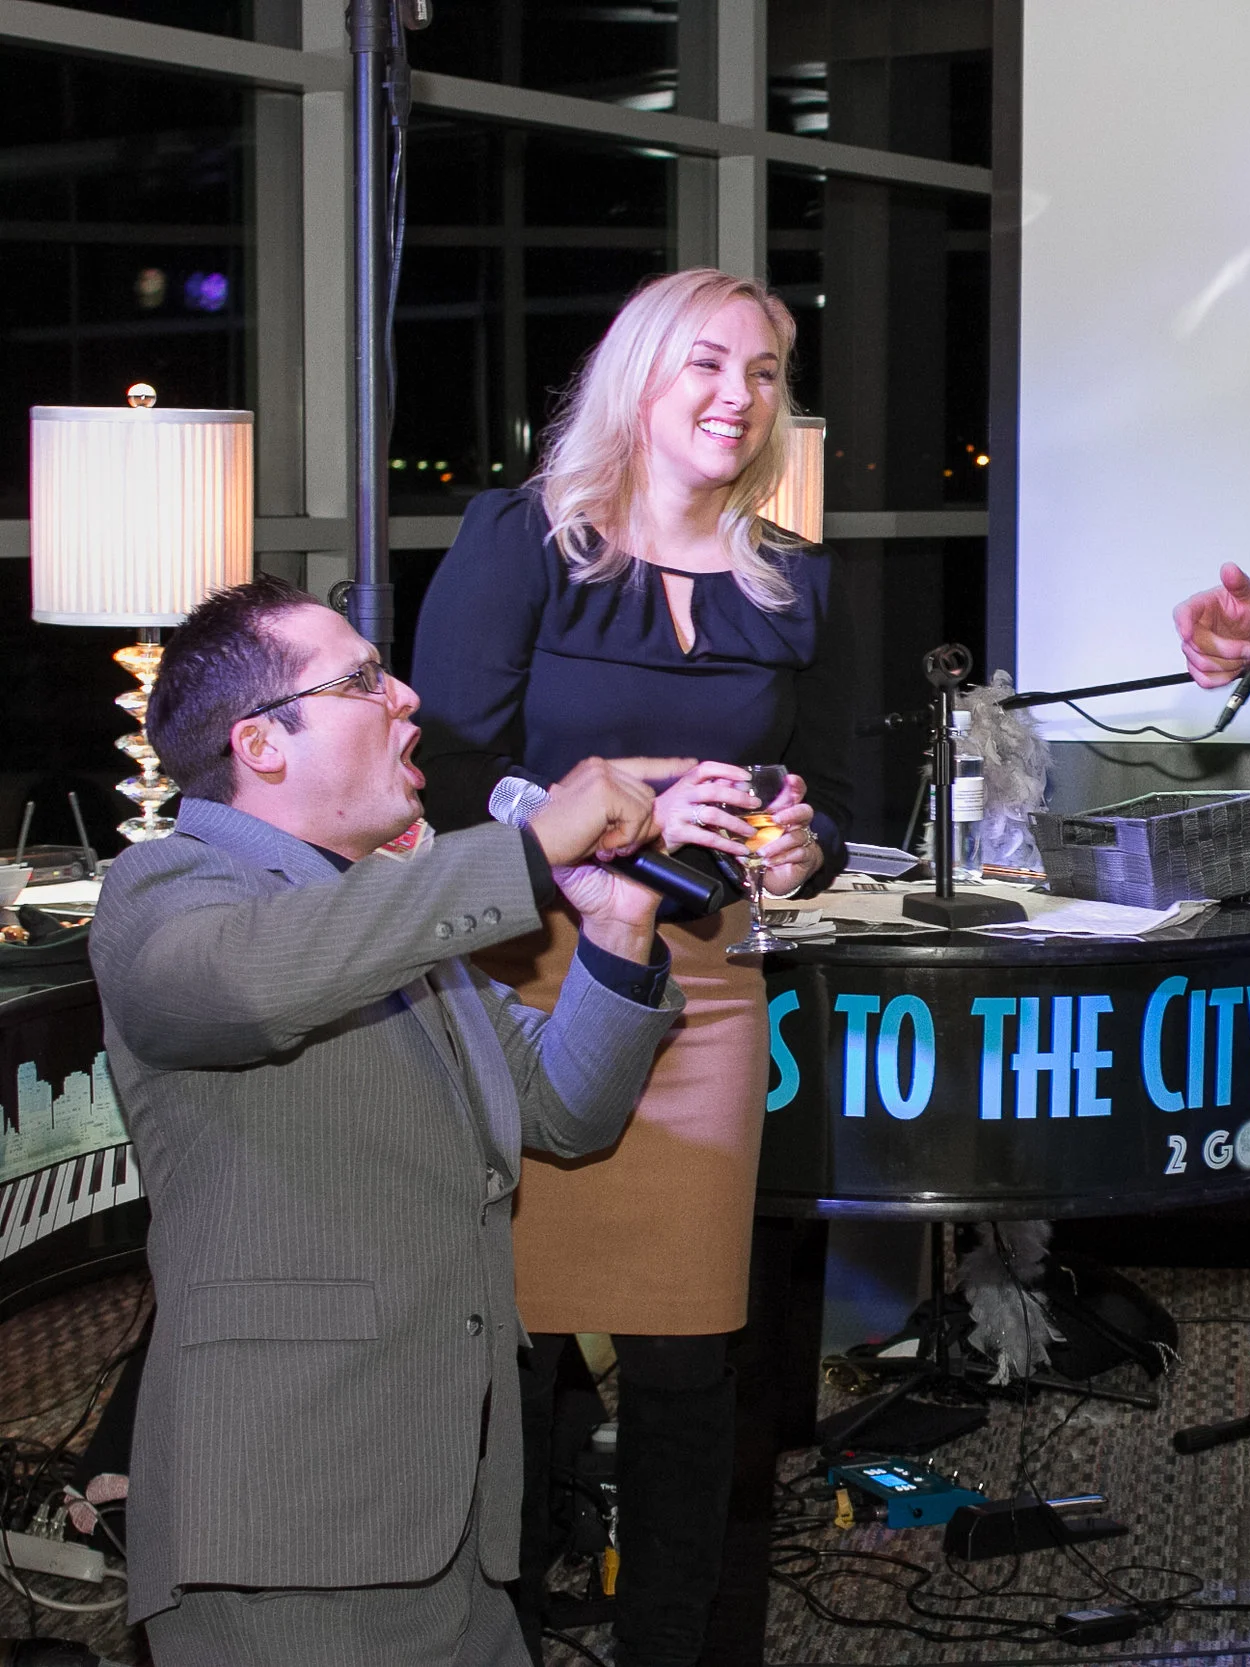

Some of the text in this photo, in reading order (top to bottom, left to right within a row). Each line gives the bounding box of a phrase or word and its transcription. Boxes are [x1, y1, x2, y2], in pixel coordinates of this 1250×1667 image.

[834, 993, 936, 1120] TO
[970, 995, 1114, 1119] THE
[1164, 1134, 1188, 1175] 2
